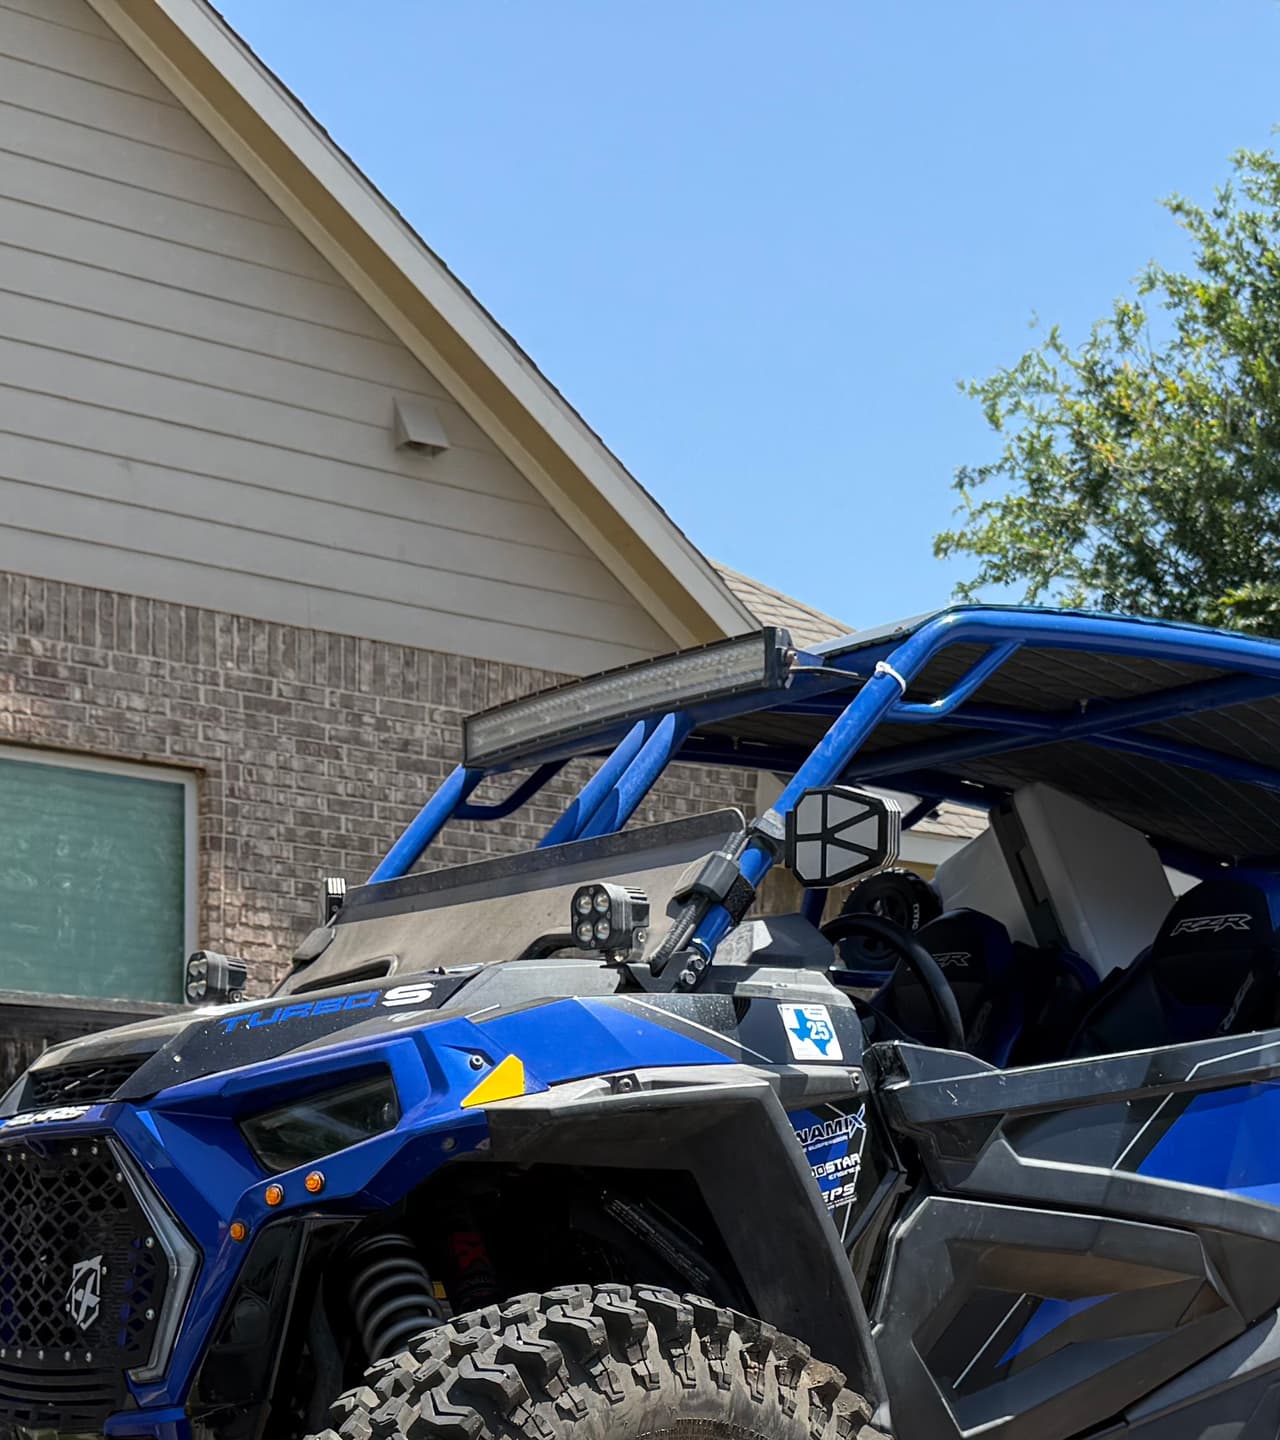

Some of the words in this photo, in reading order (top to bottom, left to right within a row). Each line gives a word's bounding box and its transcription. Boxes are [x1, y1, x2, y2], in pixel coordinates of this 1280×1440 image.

[1170, 913, 1252, 937] RZR
[217, 991, 383, 1033] TURBO
[381, 982, 437, 1008] S
[806, 1020, 830, 1041] 25
